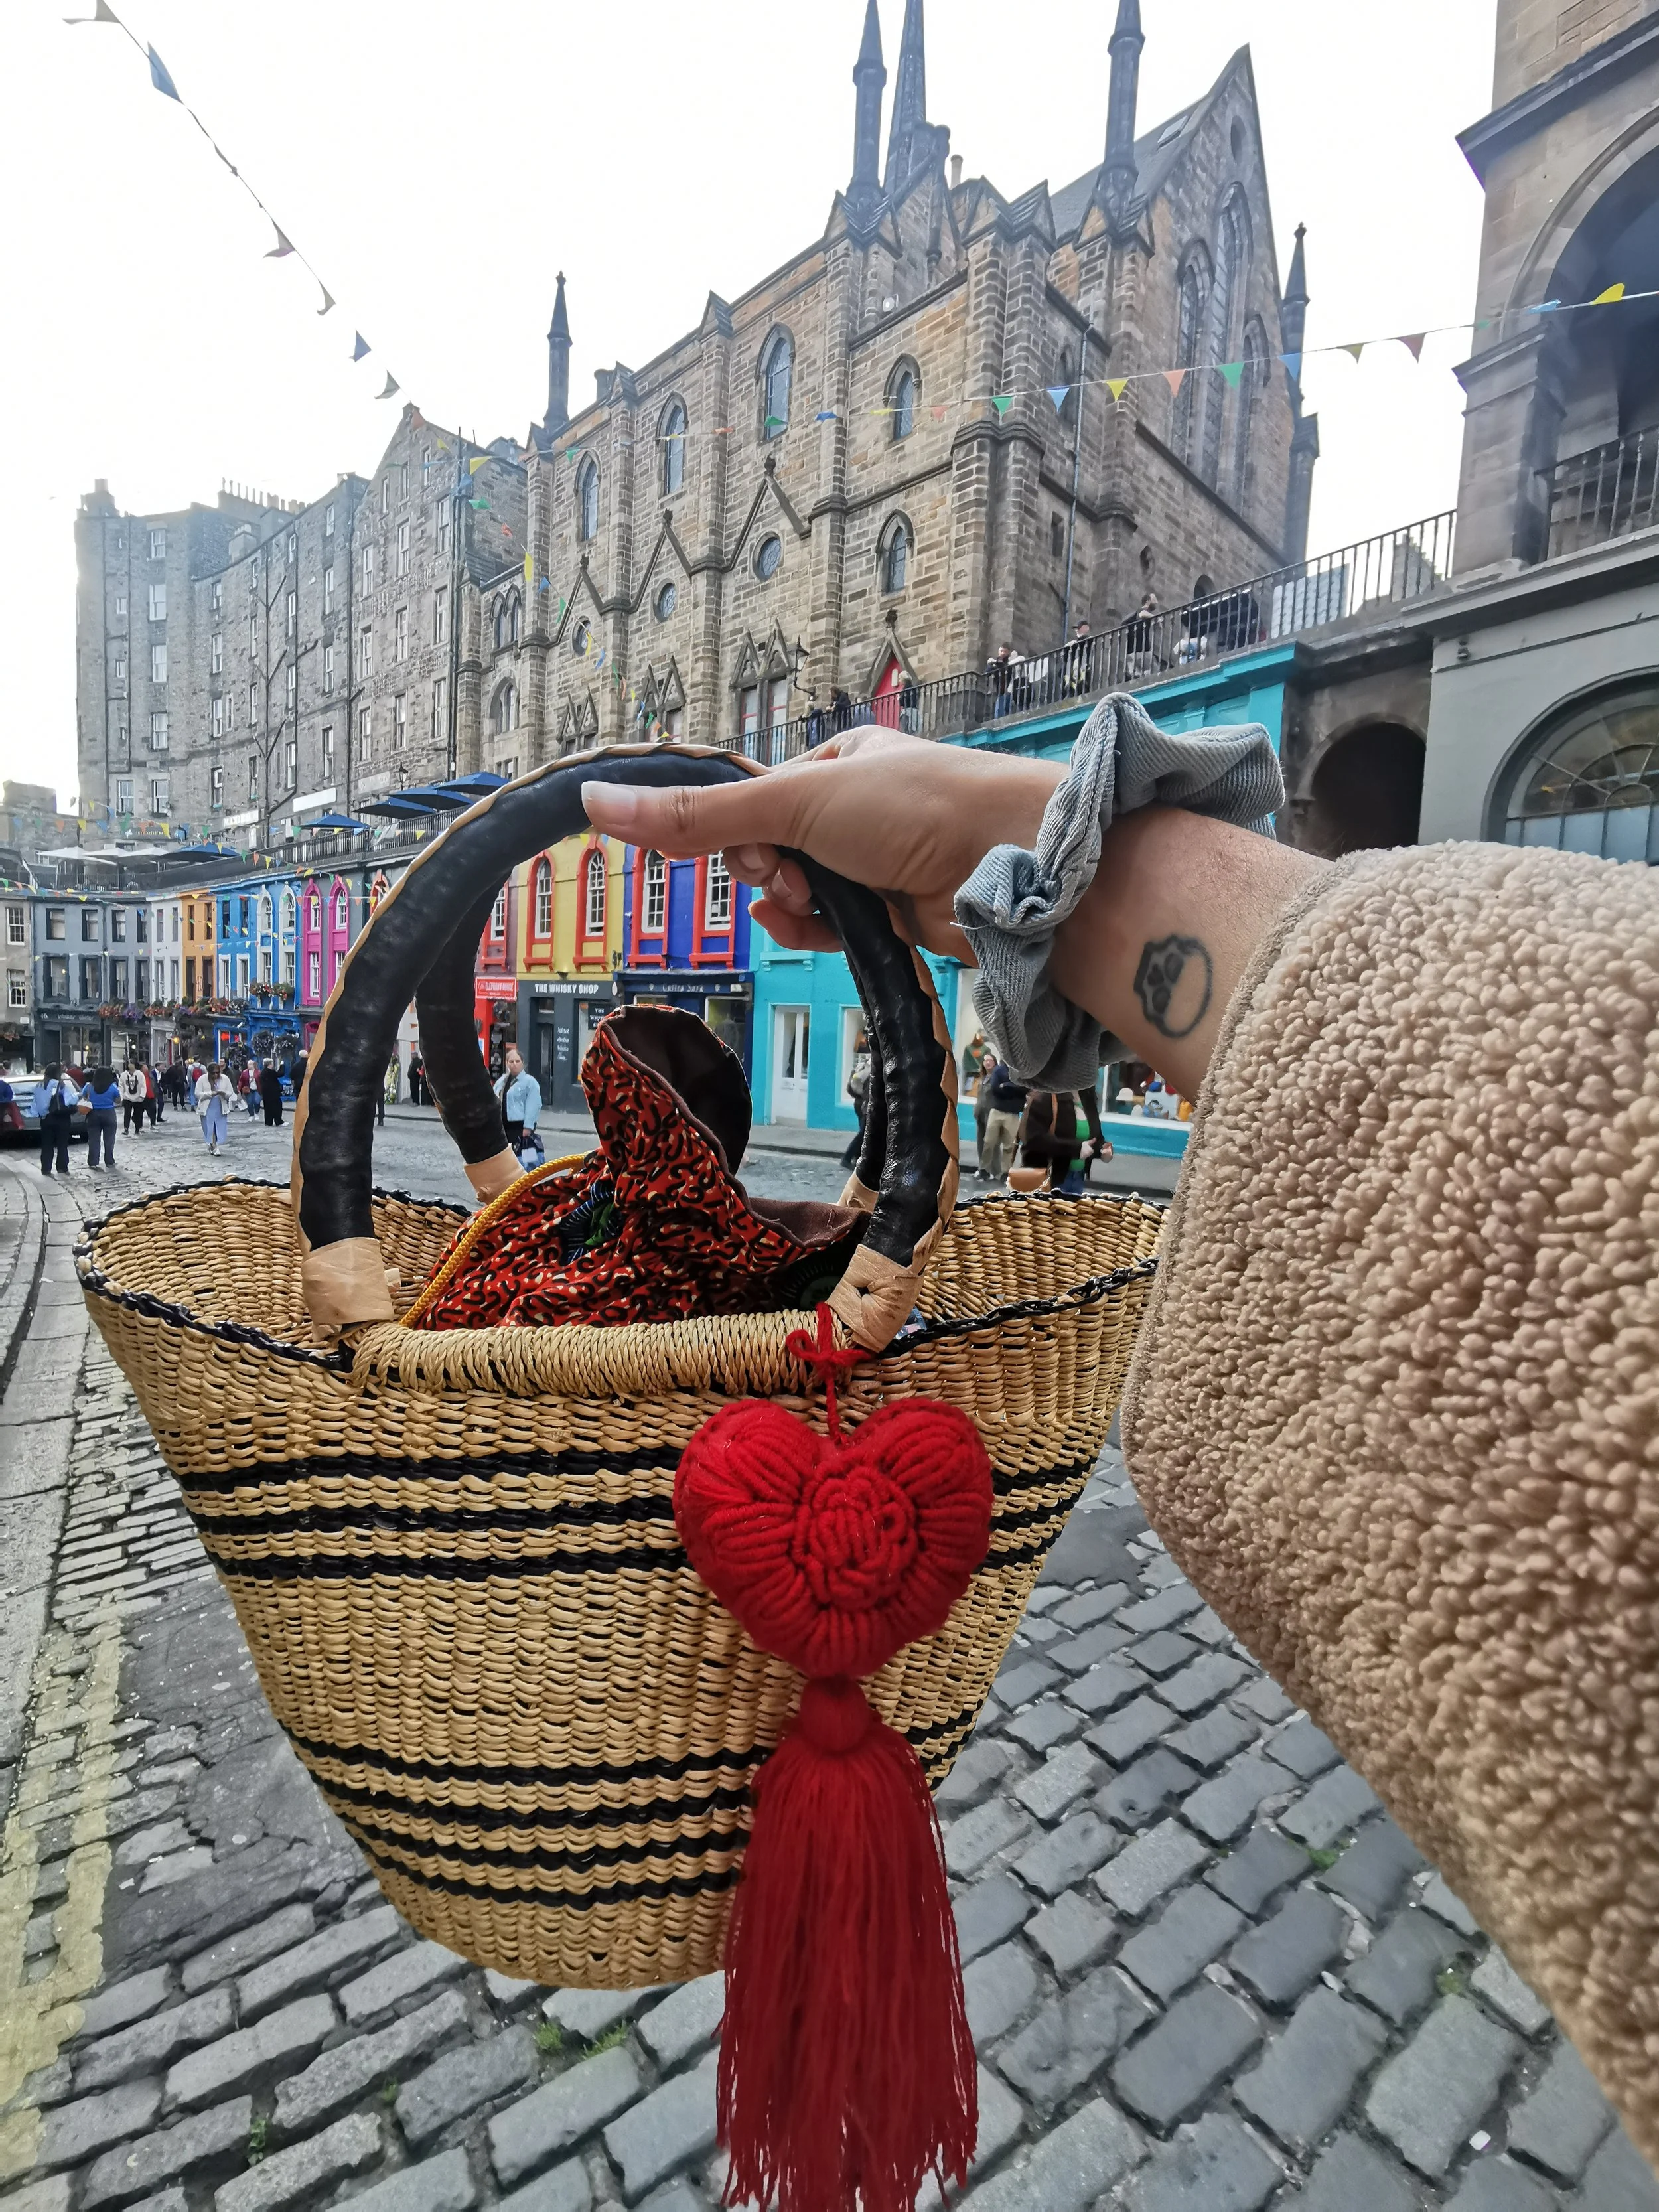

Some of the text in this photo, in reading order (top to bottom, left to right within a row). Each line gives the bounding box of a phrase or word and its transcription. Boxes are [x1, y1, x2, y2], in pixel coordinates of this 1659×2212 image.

[535, 984, 599, 994] THE WHISKY SHOP
